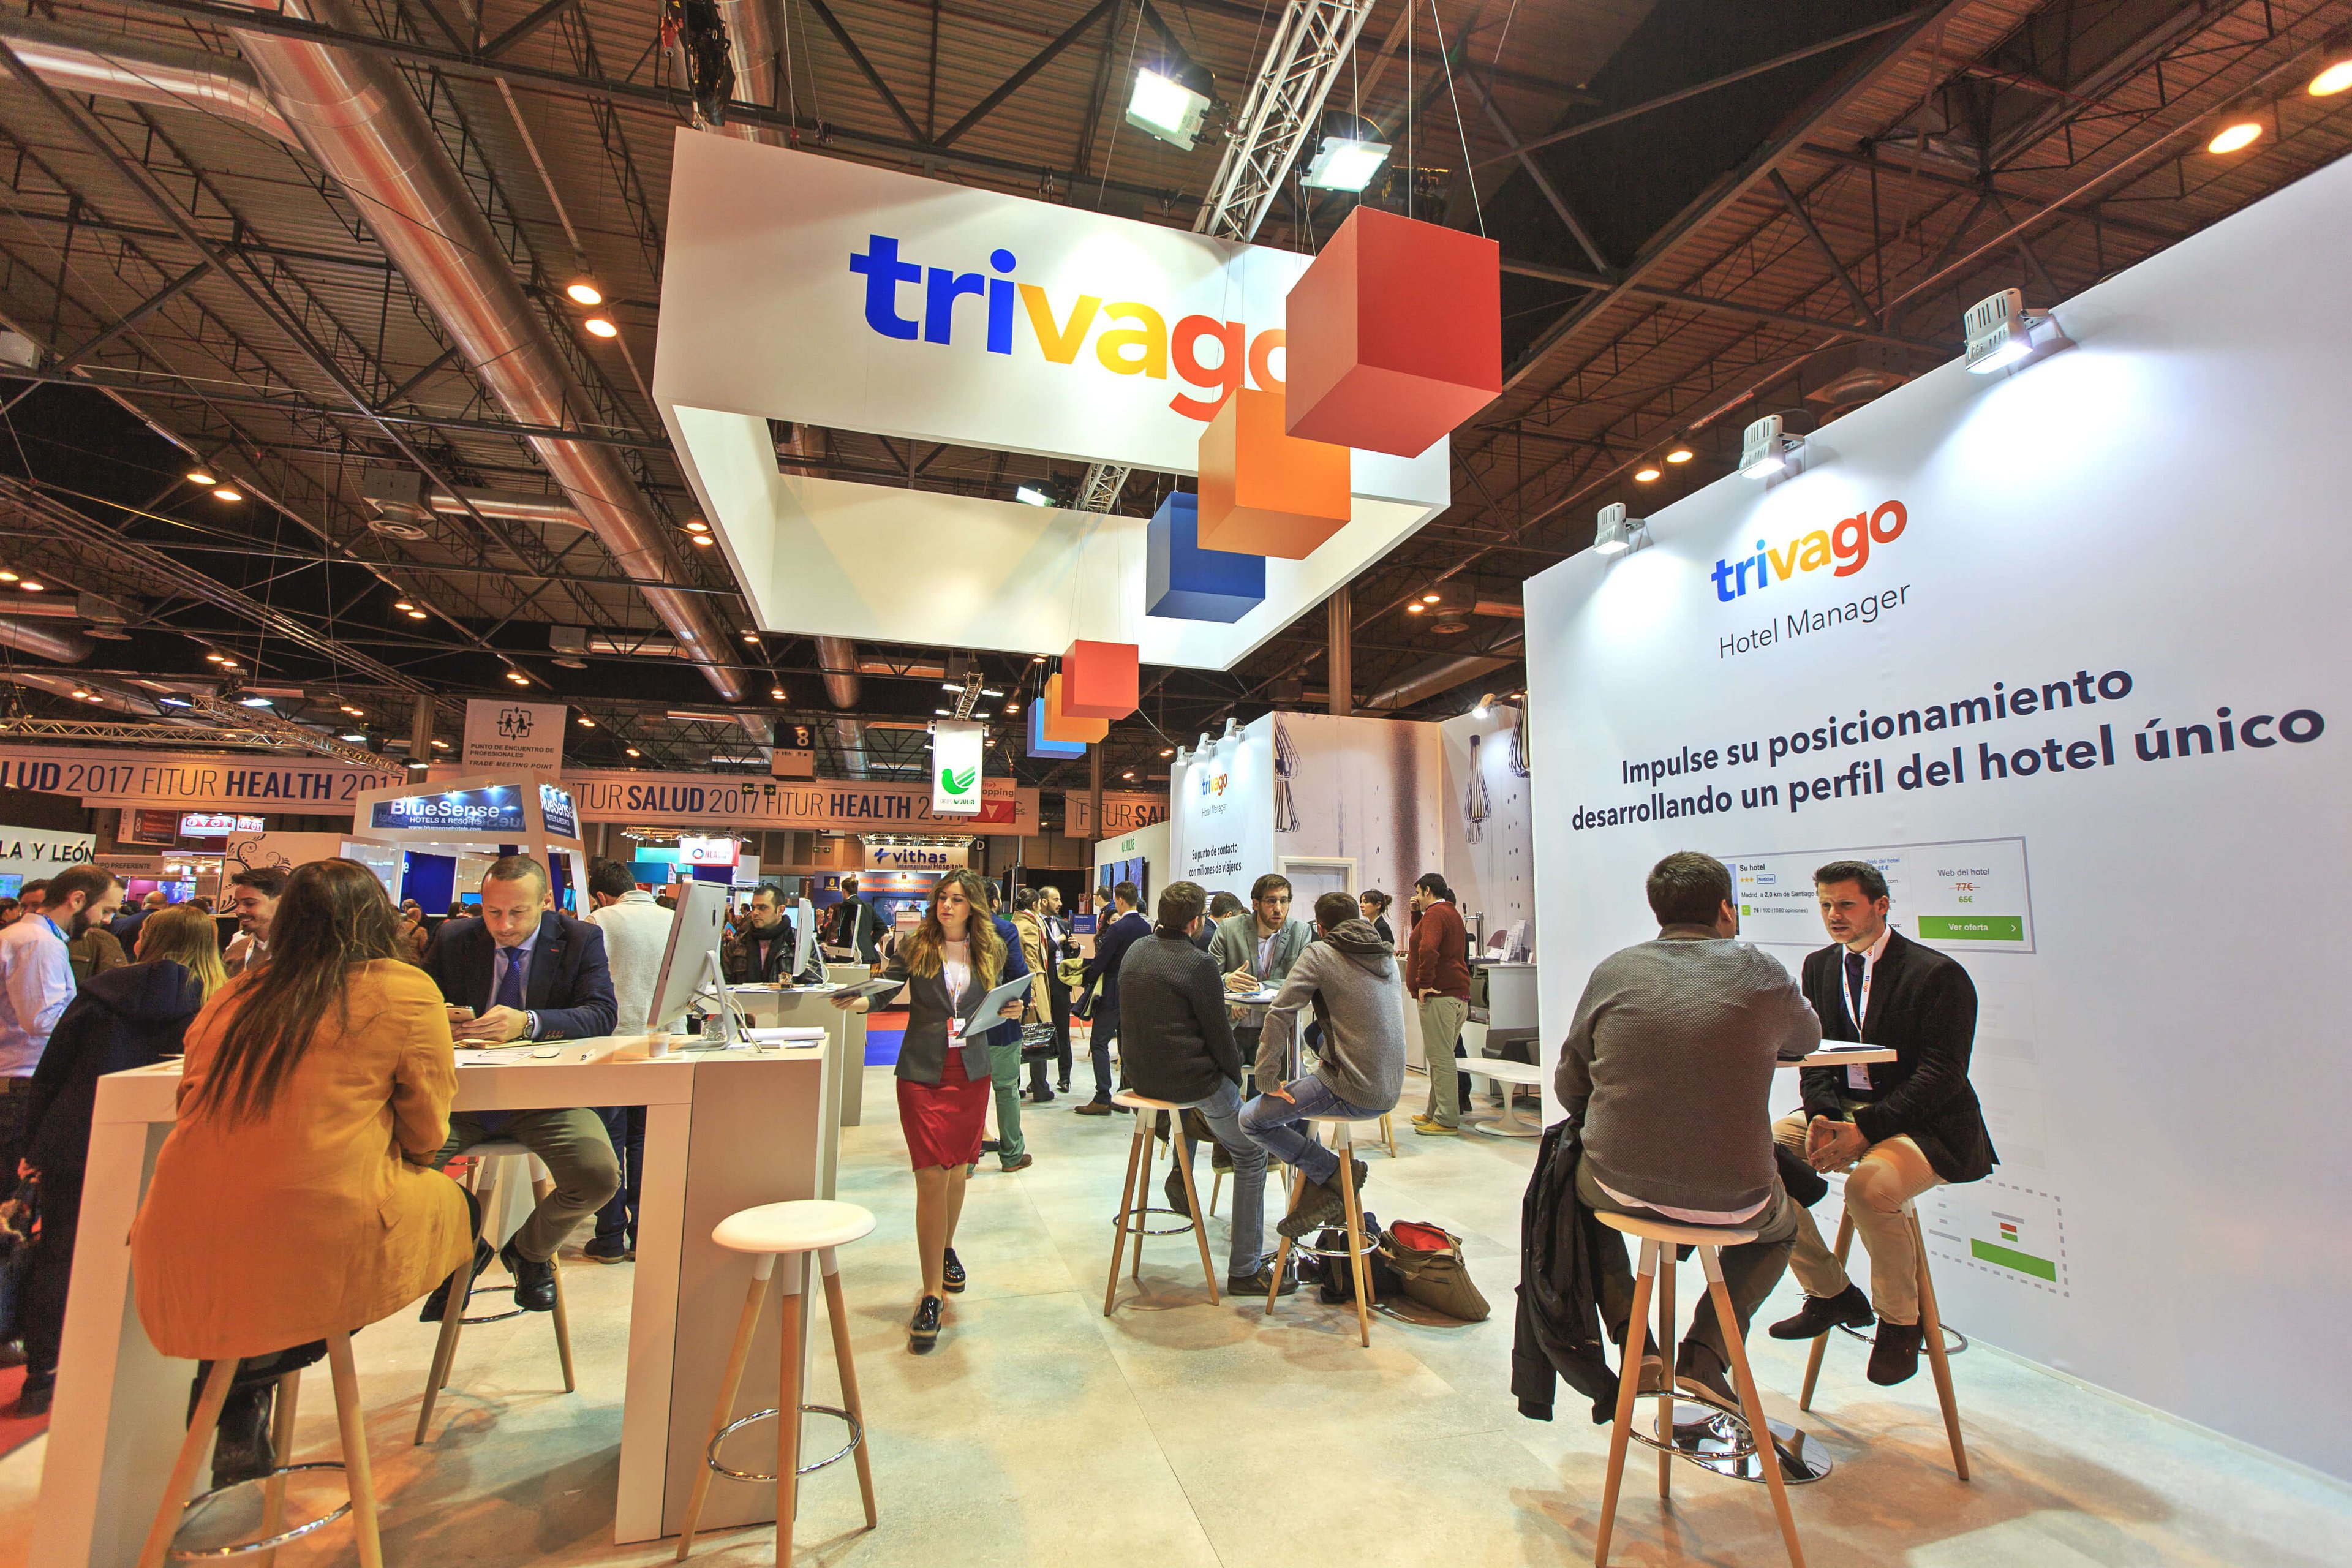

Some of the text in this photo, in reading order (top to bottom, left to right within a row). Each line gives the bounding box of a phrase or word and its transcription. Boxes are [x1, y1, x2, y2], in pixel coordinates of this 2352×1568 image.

[1711, 500, 1907, 603] trivago
[1719, 584, 1911, 659] Hotel Manager
[1622, 669, 2133, 786] Impulse su posicionamiento
[797, 730, 809, 746] 8
[1572, 706, 2325, 831] desarrollando un perfil del hotel único
[66, 764, 134, 793] 2017
[141, 767, 217, 797] FITUR
[225, 771, 333, 799] HEALTH
[1202, 773, 1228, 796] trivago
[576, 783, 622, 810] TUR
[627, 785, 704, 812] SALUD
[709, 789, 760, 813] 2017
[766, 792, 823, 816] FITUR
[830, 794, 911, 819] HEALTH
[982, 788, 1014, 797] opping
[391, 800, 500, 818] BlueSense
[1079, 802, 1131, 827] FTUR
[1202, 803, 1227, 817] Hotel Manager
[135, 818, 141, 832] 8
[239, 821, 262, 831] over
[34, 843, 45, 859] Y
[52, 841, 95, 862] LEÓN
[976, 840, 985, 850] D
[1192, 842, 1238, 862] Su punto de contacto
[892, 849, 947, 863] vithas
[1197, 863, 1215, 875] millones
[1215, 862, 1221, 873] de
[1222, 861, 1242, 877] viajeros
[1937, 867, 1990, 877] Web del hotel
[1955, 883, 1973, 891] 77€
[1963, 922, 1988, 932] oferta
